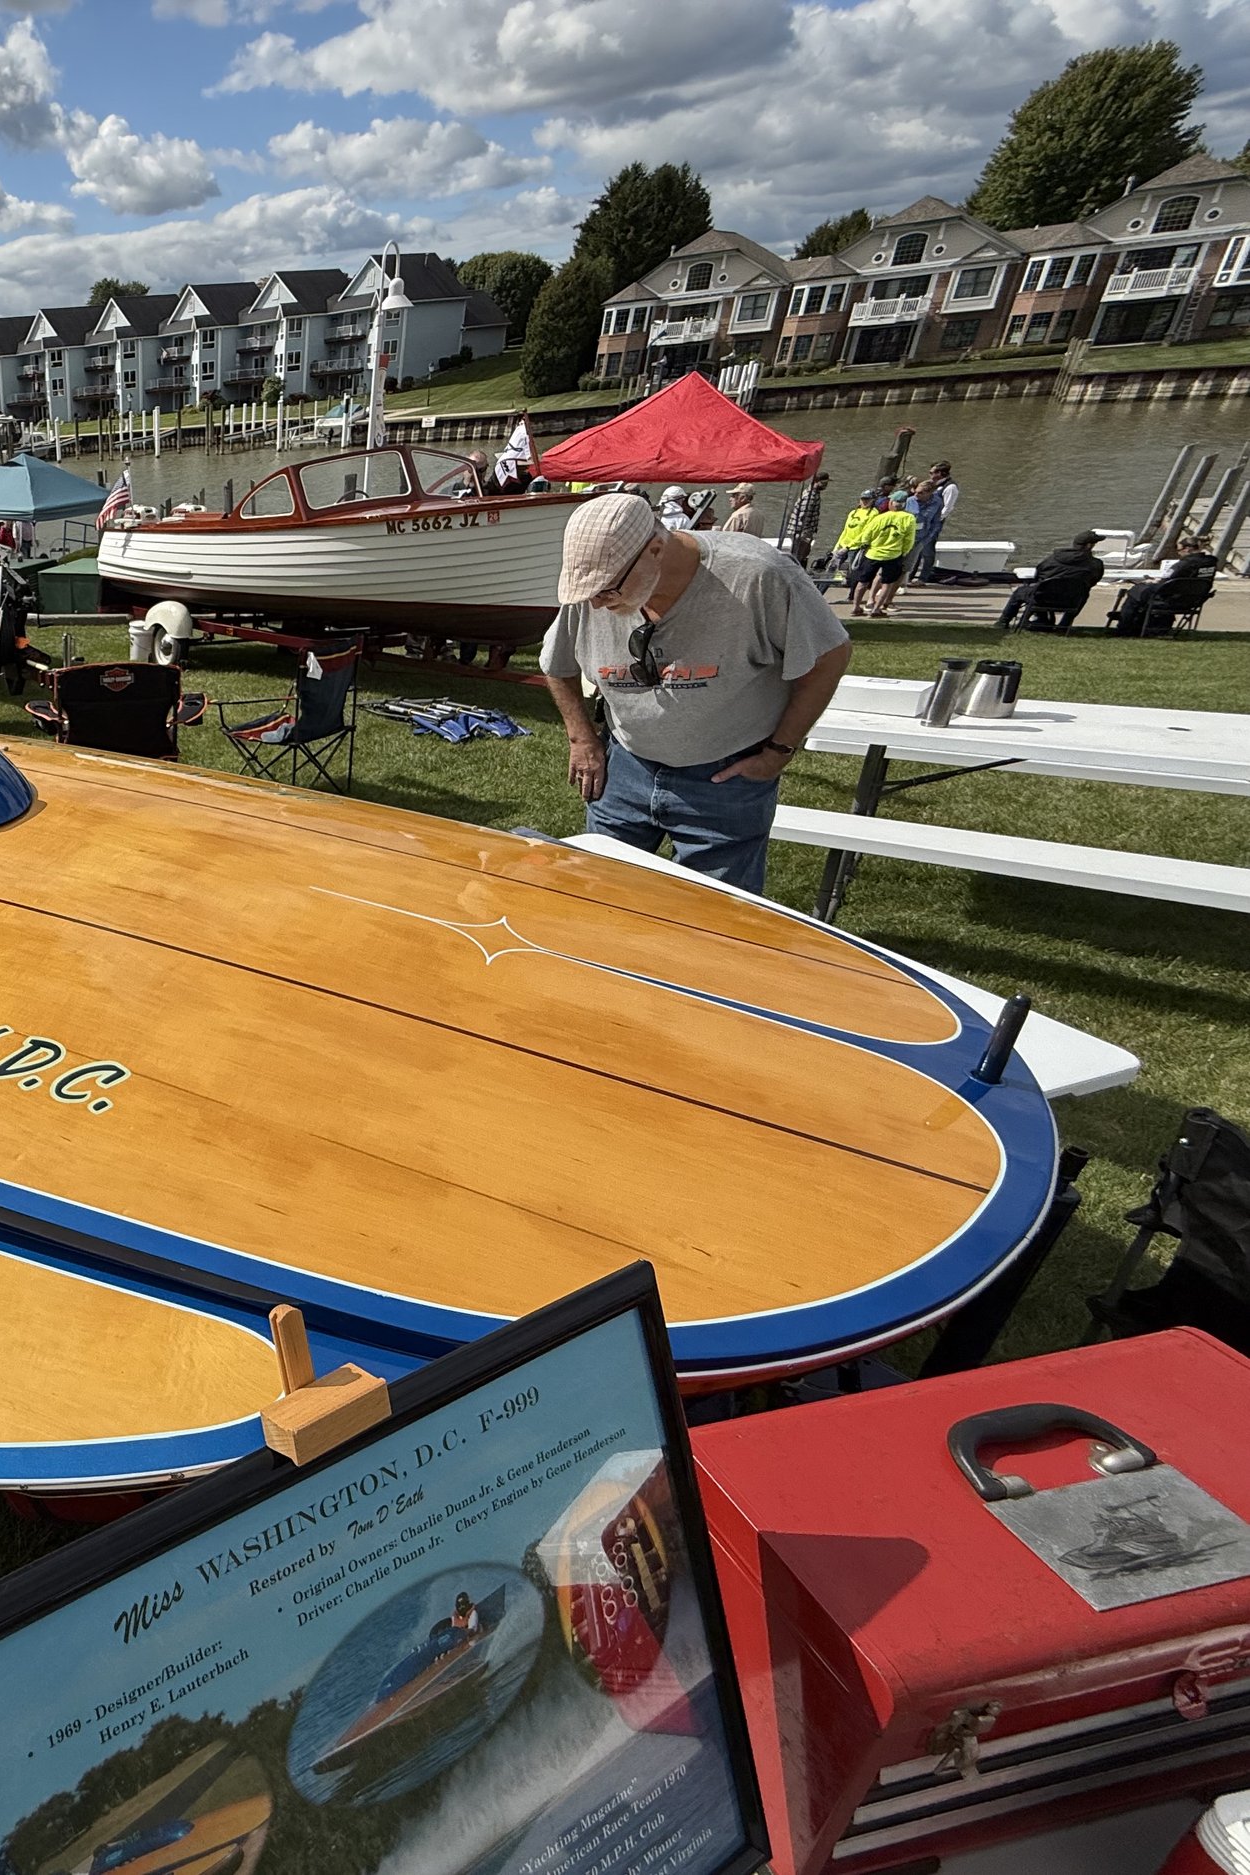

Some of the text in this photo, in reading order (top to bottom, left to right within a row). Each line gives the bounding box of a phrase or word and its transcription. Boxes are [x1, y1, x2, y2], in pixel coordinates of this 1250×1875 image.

[386, 511, 480, 535] MC 5662 JZ
[114, 1385, 541, 1644] Miss WASHINGTON, D.C. F-999
[248, 1484, 425, 1597] Restored by Tom D'Eath
[291, 1429, 592, 1606] Original Owners: Charlie Dunn Jr. & Gene Henderson
[296, 1427, 627, 1627] Driver: Charlie Dunn Jr. Chevy Engine by Gene Henderson
[47, 1719, 83, 1749] 1969
[93, 1640, 224, 1722] Designer/Builder:
[98, 1647, 251, 1745] Henry E. Lauterbach
[599, 1812, 666, 1873] M.P.H. Club
[602, 1811, 631, 1840] Race
[630, 1786, 663, 1815] Team
[663, 1763, 687, 1791] 1970
[643, 1828, 684, 1865] Winner
[669, 1826, 713, 1867] Virginia
